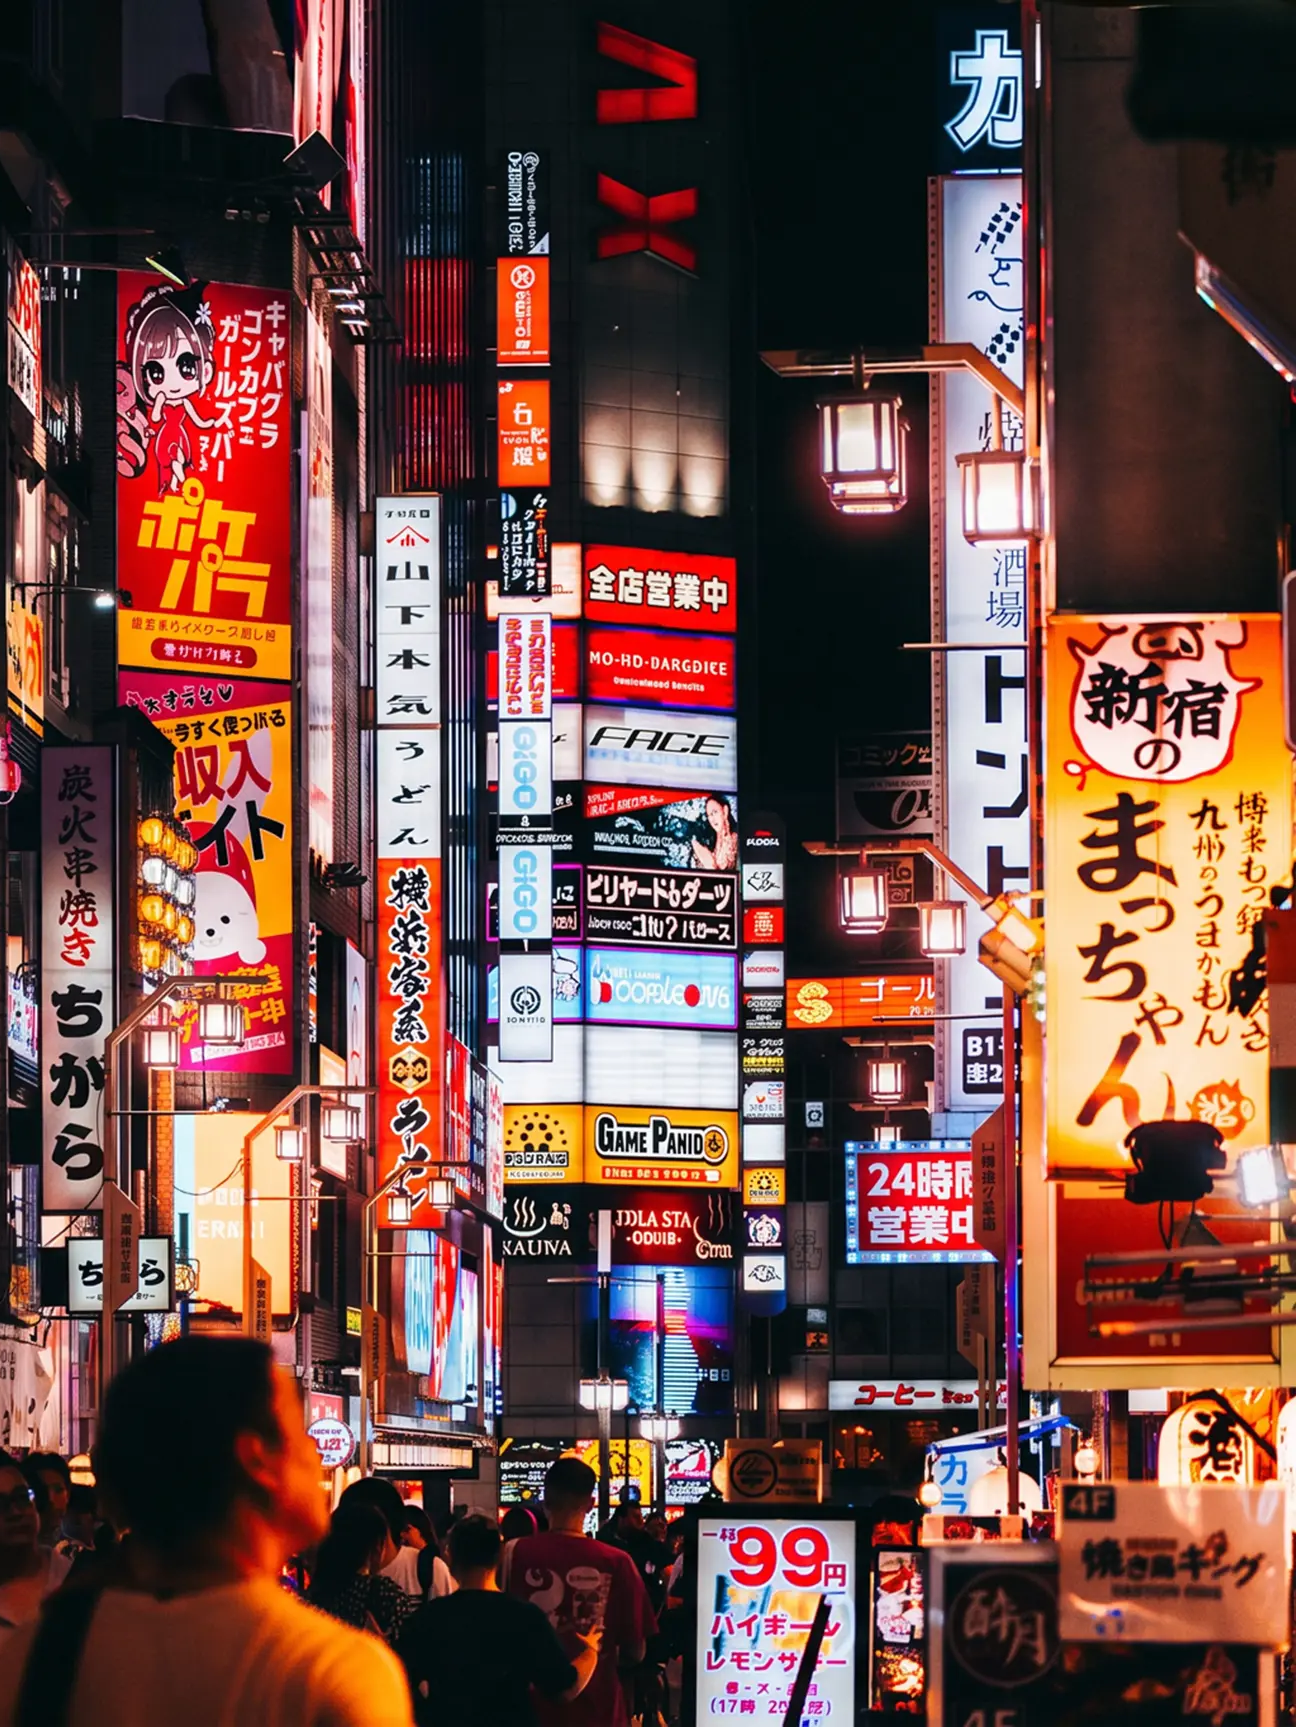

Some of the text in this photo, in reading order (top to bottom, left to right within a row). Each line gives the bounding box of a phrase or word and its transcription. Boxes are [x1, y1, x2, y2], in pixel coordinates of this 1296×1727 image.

[588, 564, 729, 614] 全店営業中
[1081, 661, 1229, 741] 新宿
[589, 726, 730, 757] FACE
[57, 763, 99, 968] 炭火串焼き
[51, 982, 104, 1183] ちから
[854, 1384, 936, 1405] コーヒー
[1068, 1490, 1111, 1517] 4F
